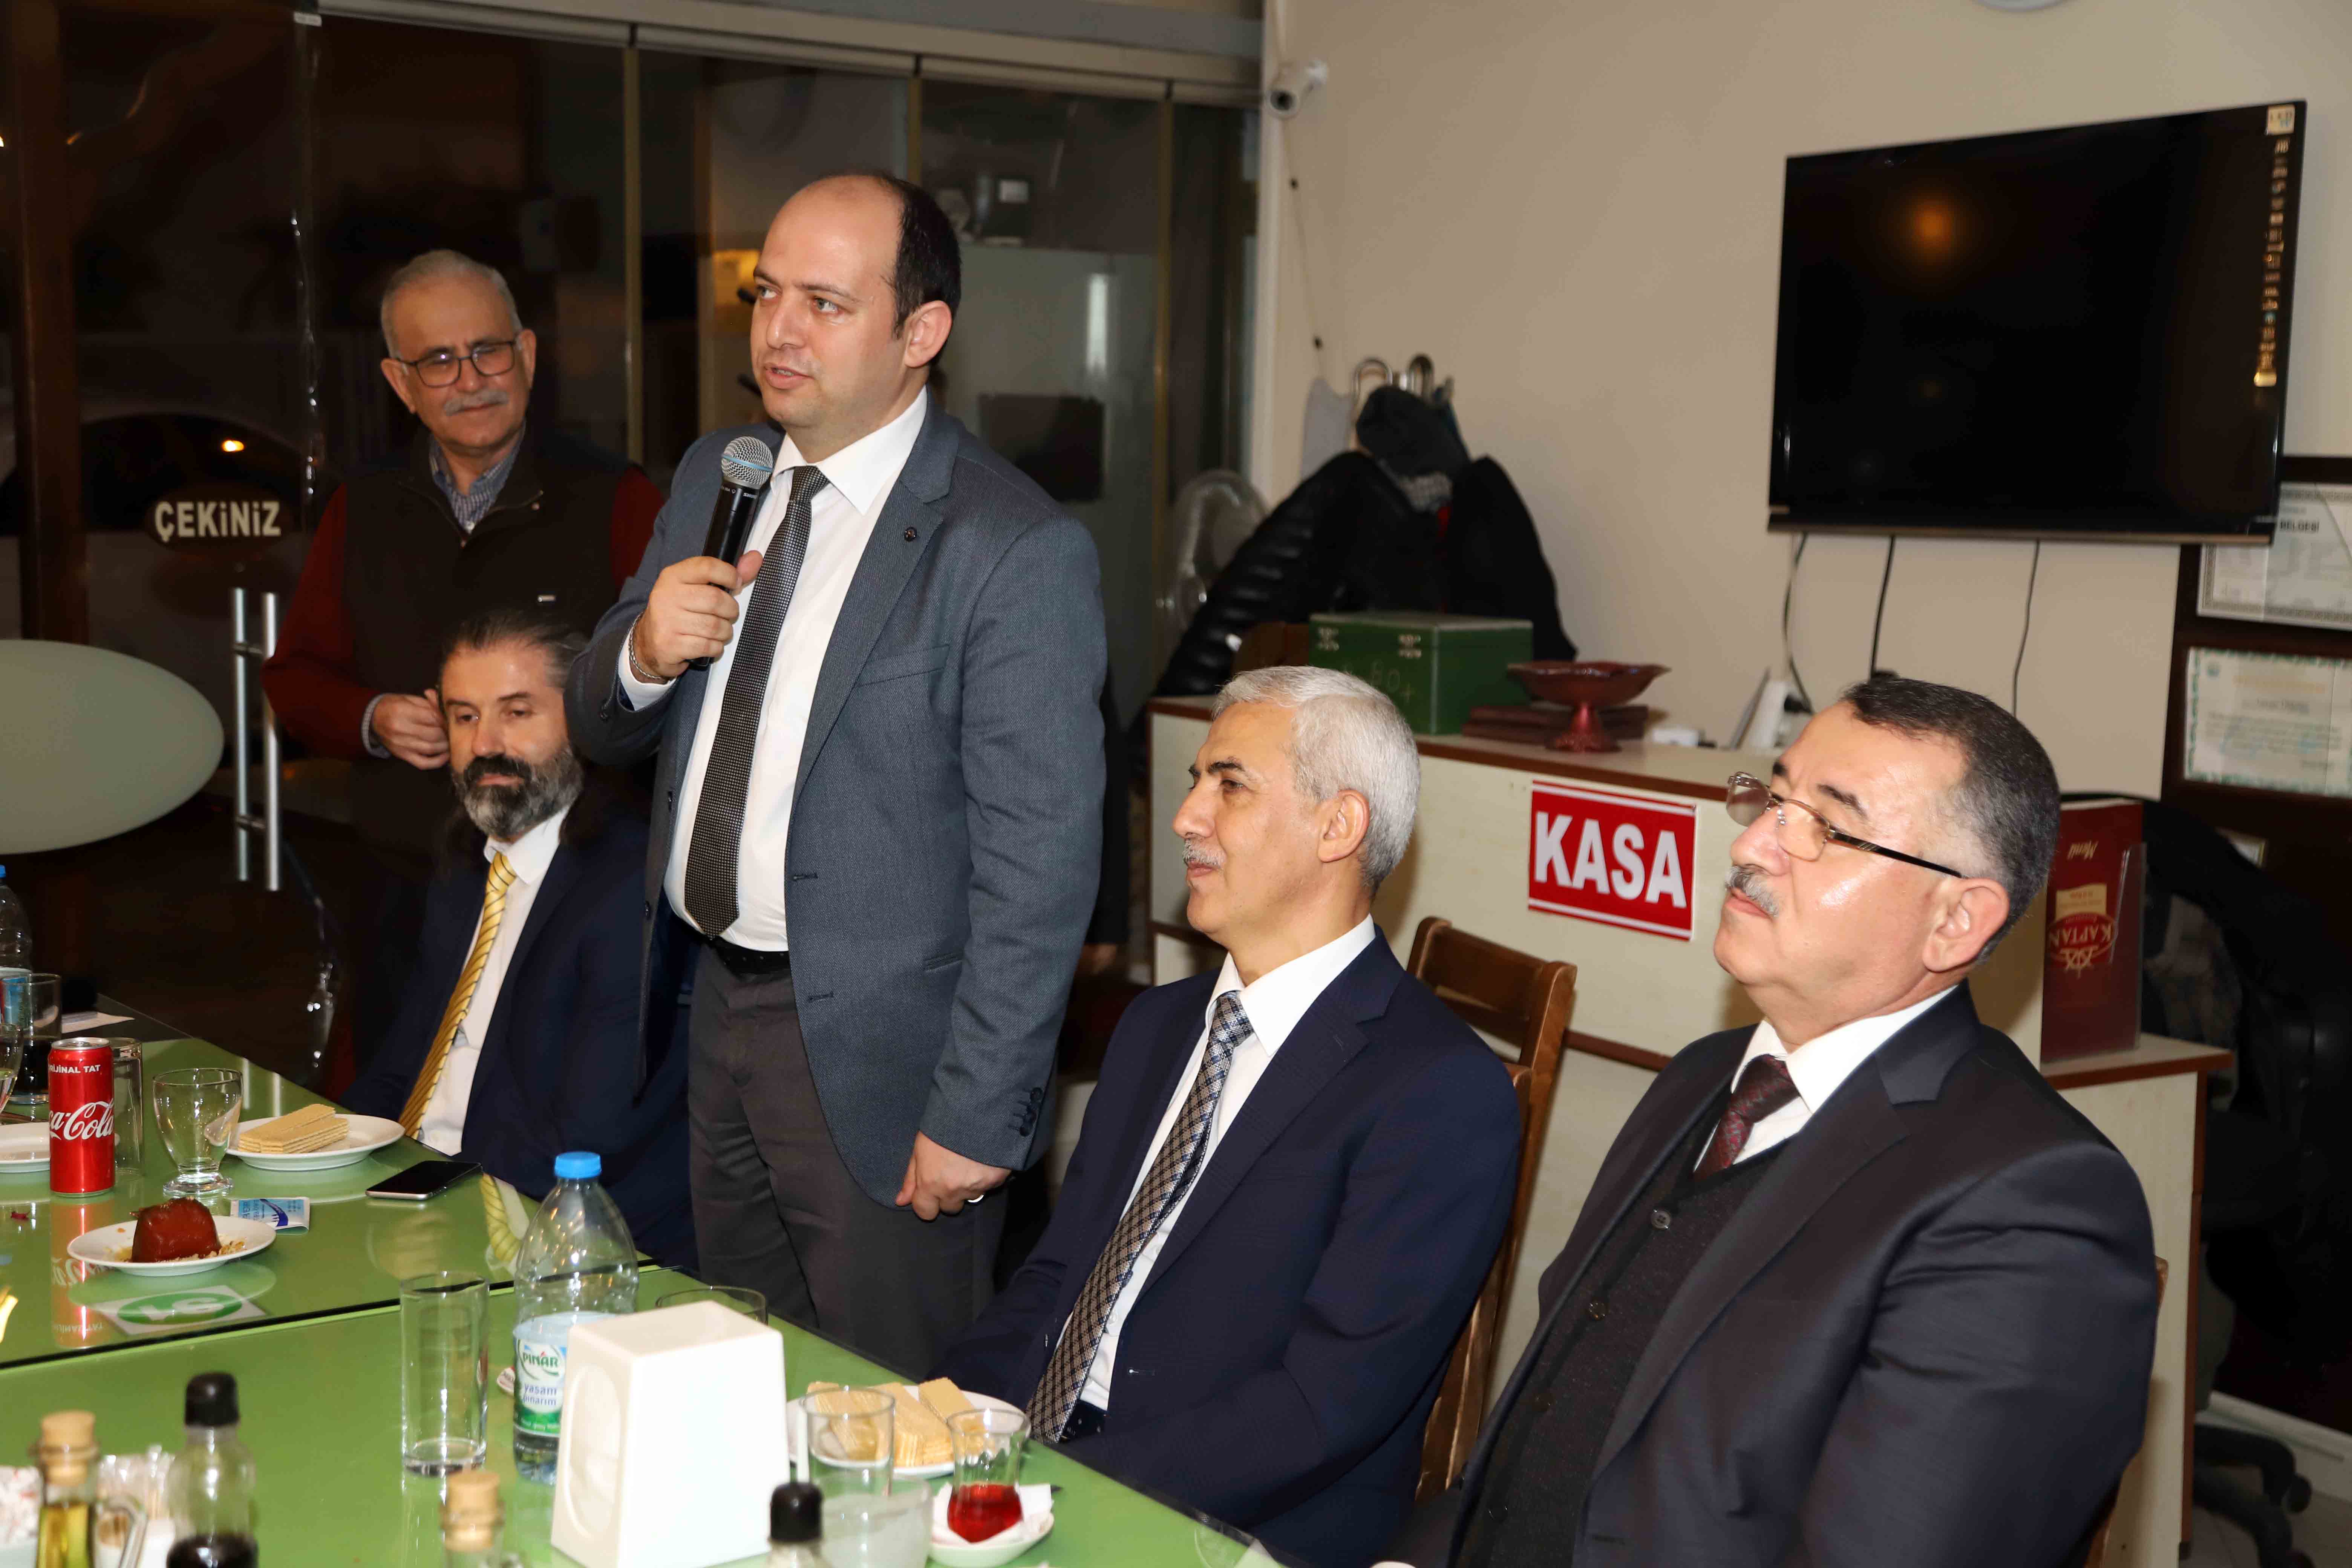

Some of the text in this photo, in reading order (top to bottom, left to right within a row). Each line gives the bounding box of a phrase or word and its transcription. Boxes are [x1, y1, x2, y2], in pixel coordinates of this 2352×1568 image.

[155, 501, 282, 543] ÇEKİNİZ
[1535, 812, 1687, 908] KASA
[2049, 923, 2112, 947] KAPTAN
[49, 1064, 101, 1073] RİJİNAL TAT
[49, 1098, 114, 1140] ca-Cola
